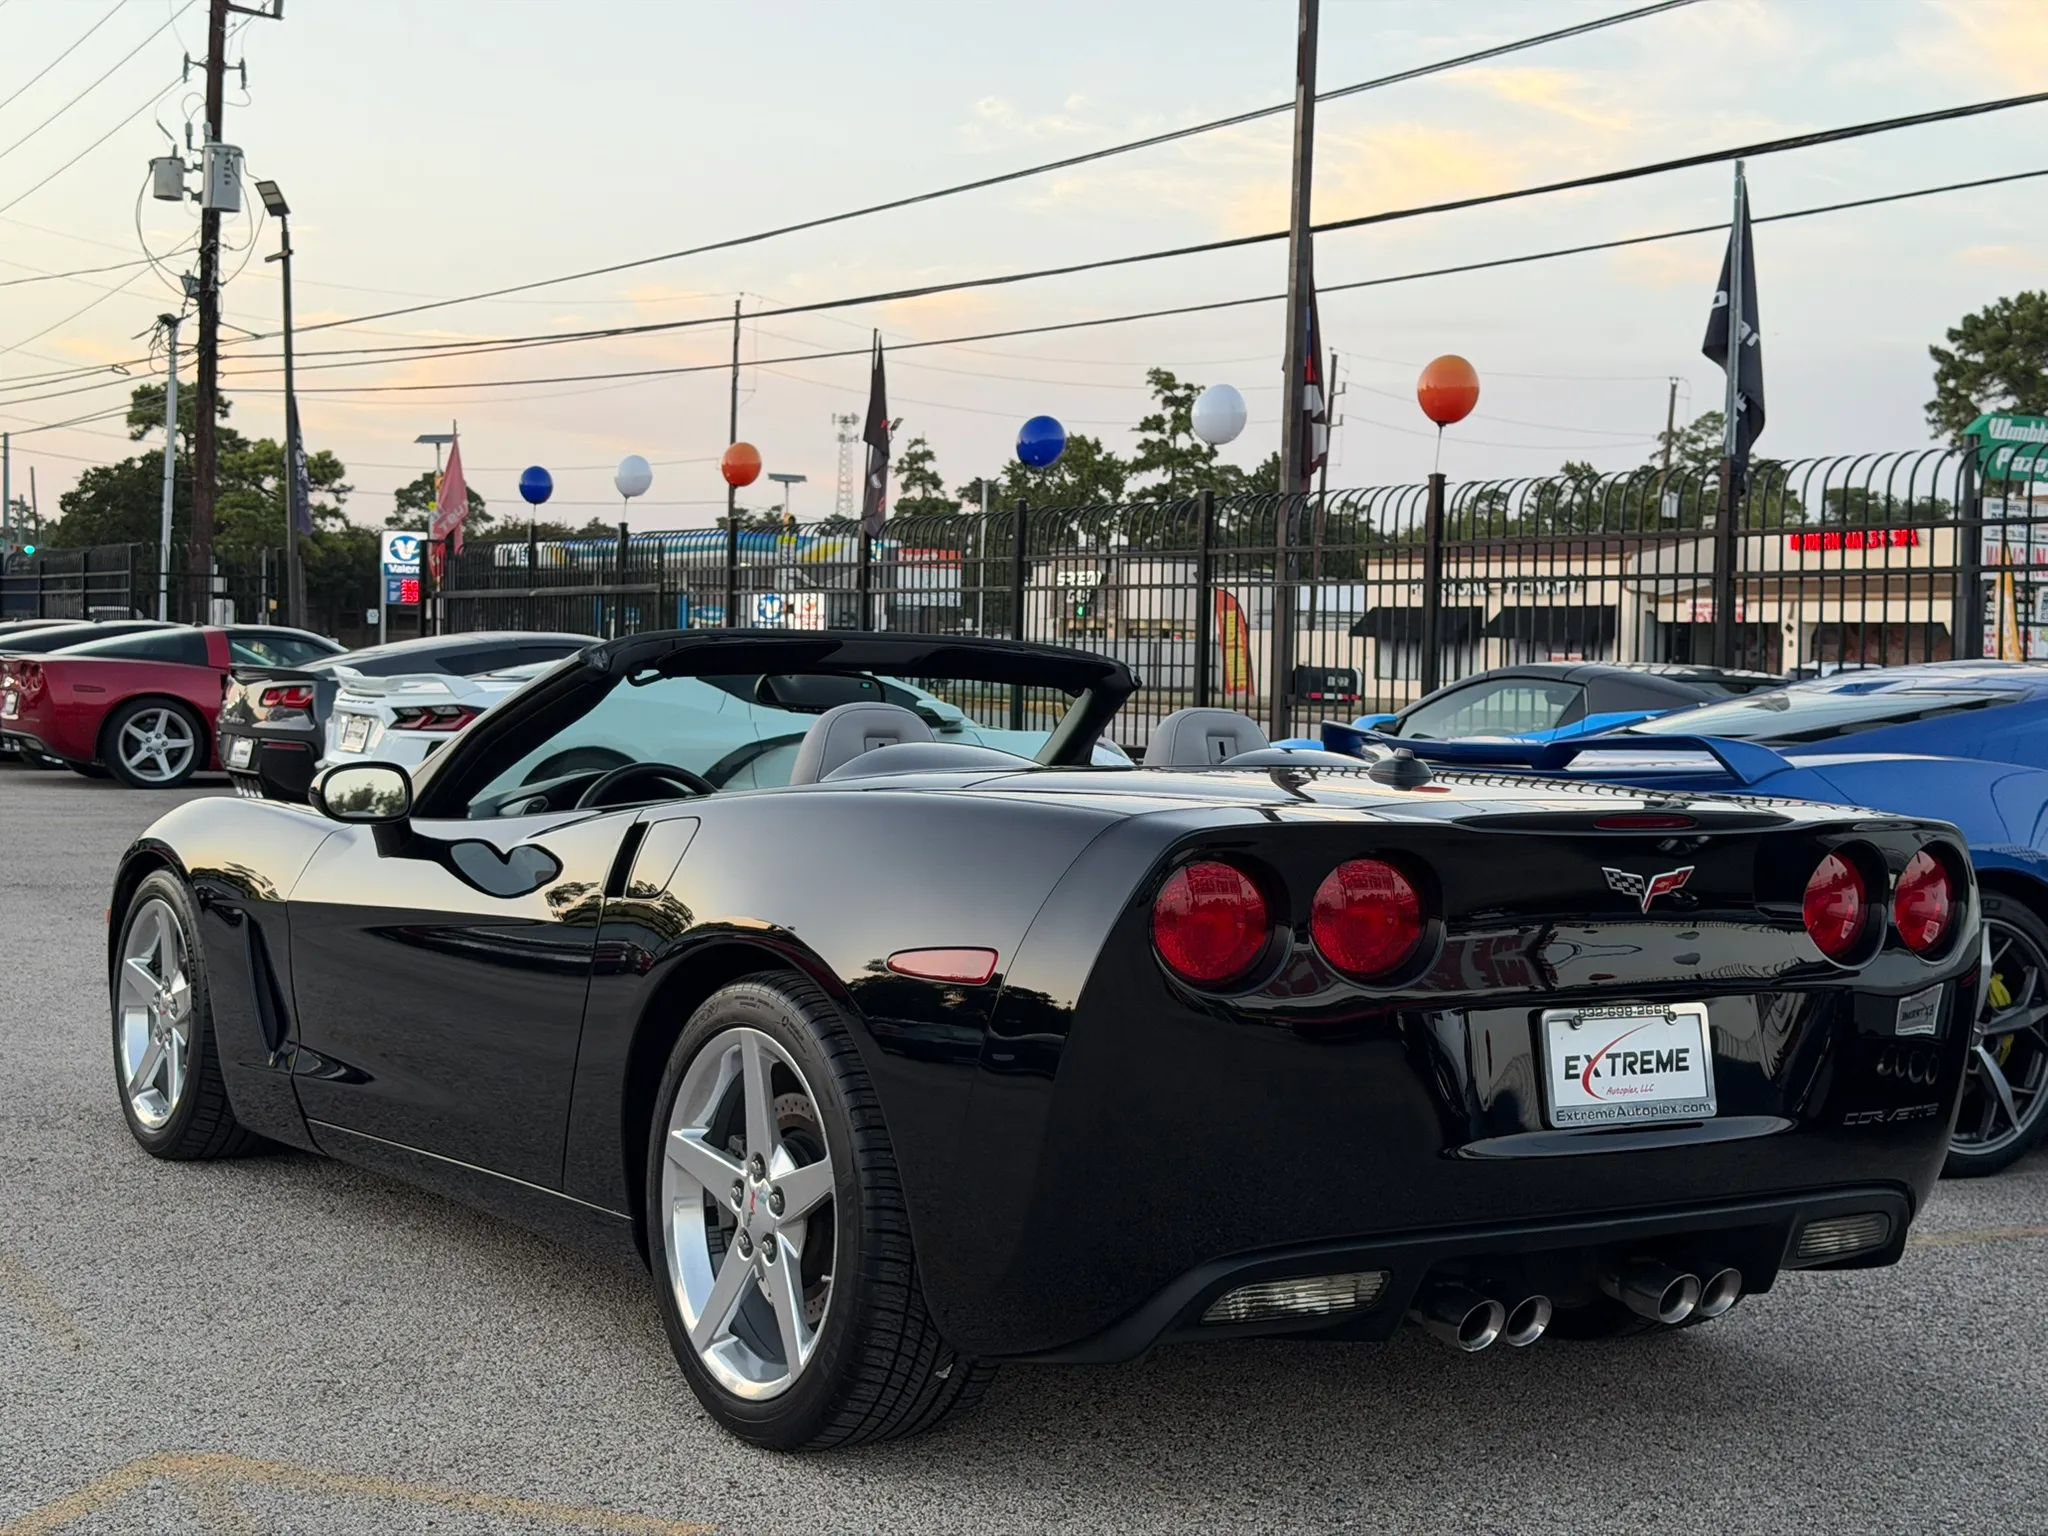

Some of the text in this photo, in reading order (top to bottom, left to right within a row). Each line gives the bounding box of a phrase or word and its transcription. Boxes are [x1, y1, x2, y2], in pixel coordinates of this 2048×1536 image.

[1996, 446, 2046, 474] Paza
[1577, 1004, 1671, 1018] 832-698-2668
[1564, 1048, 1690, 1080] EXTREME
[1640, 1083, 1655, 1093] LLC
[1556, 1102, 1712, 1122] ExtremeAutoplex.com
